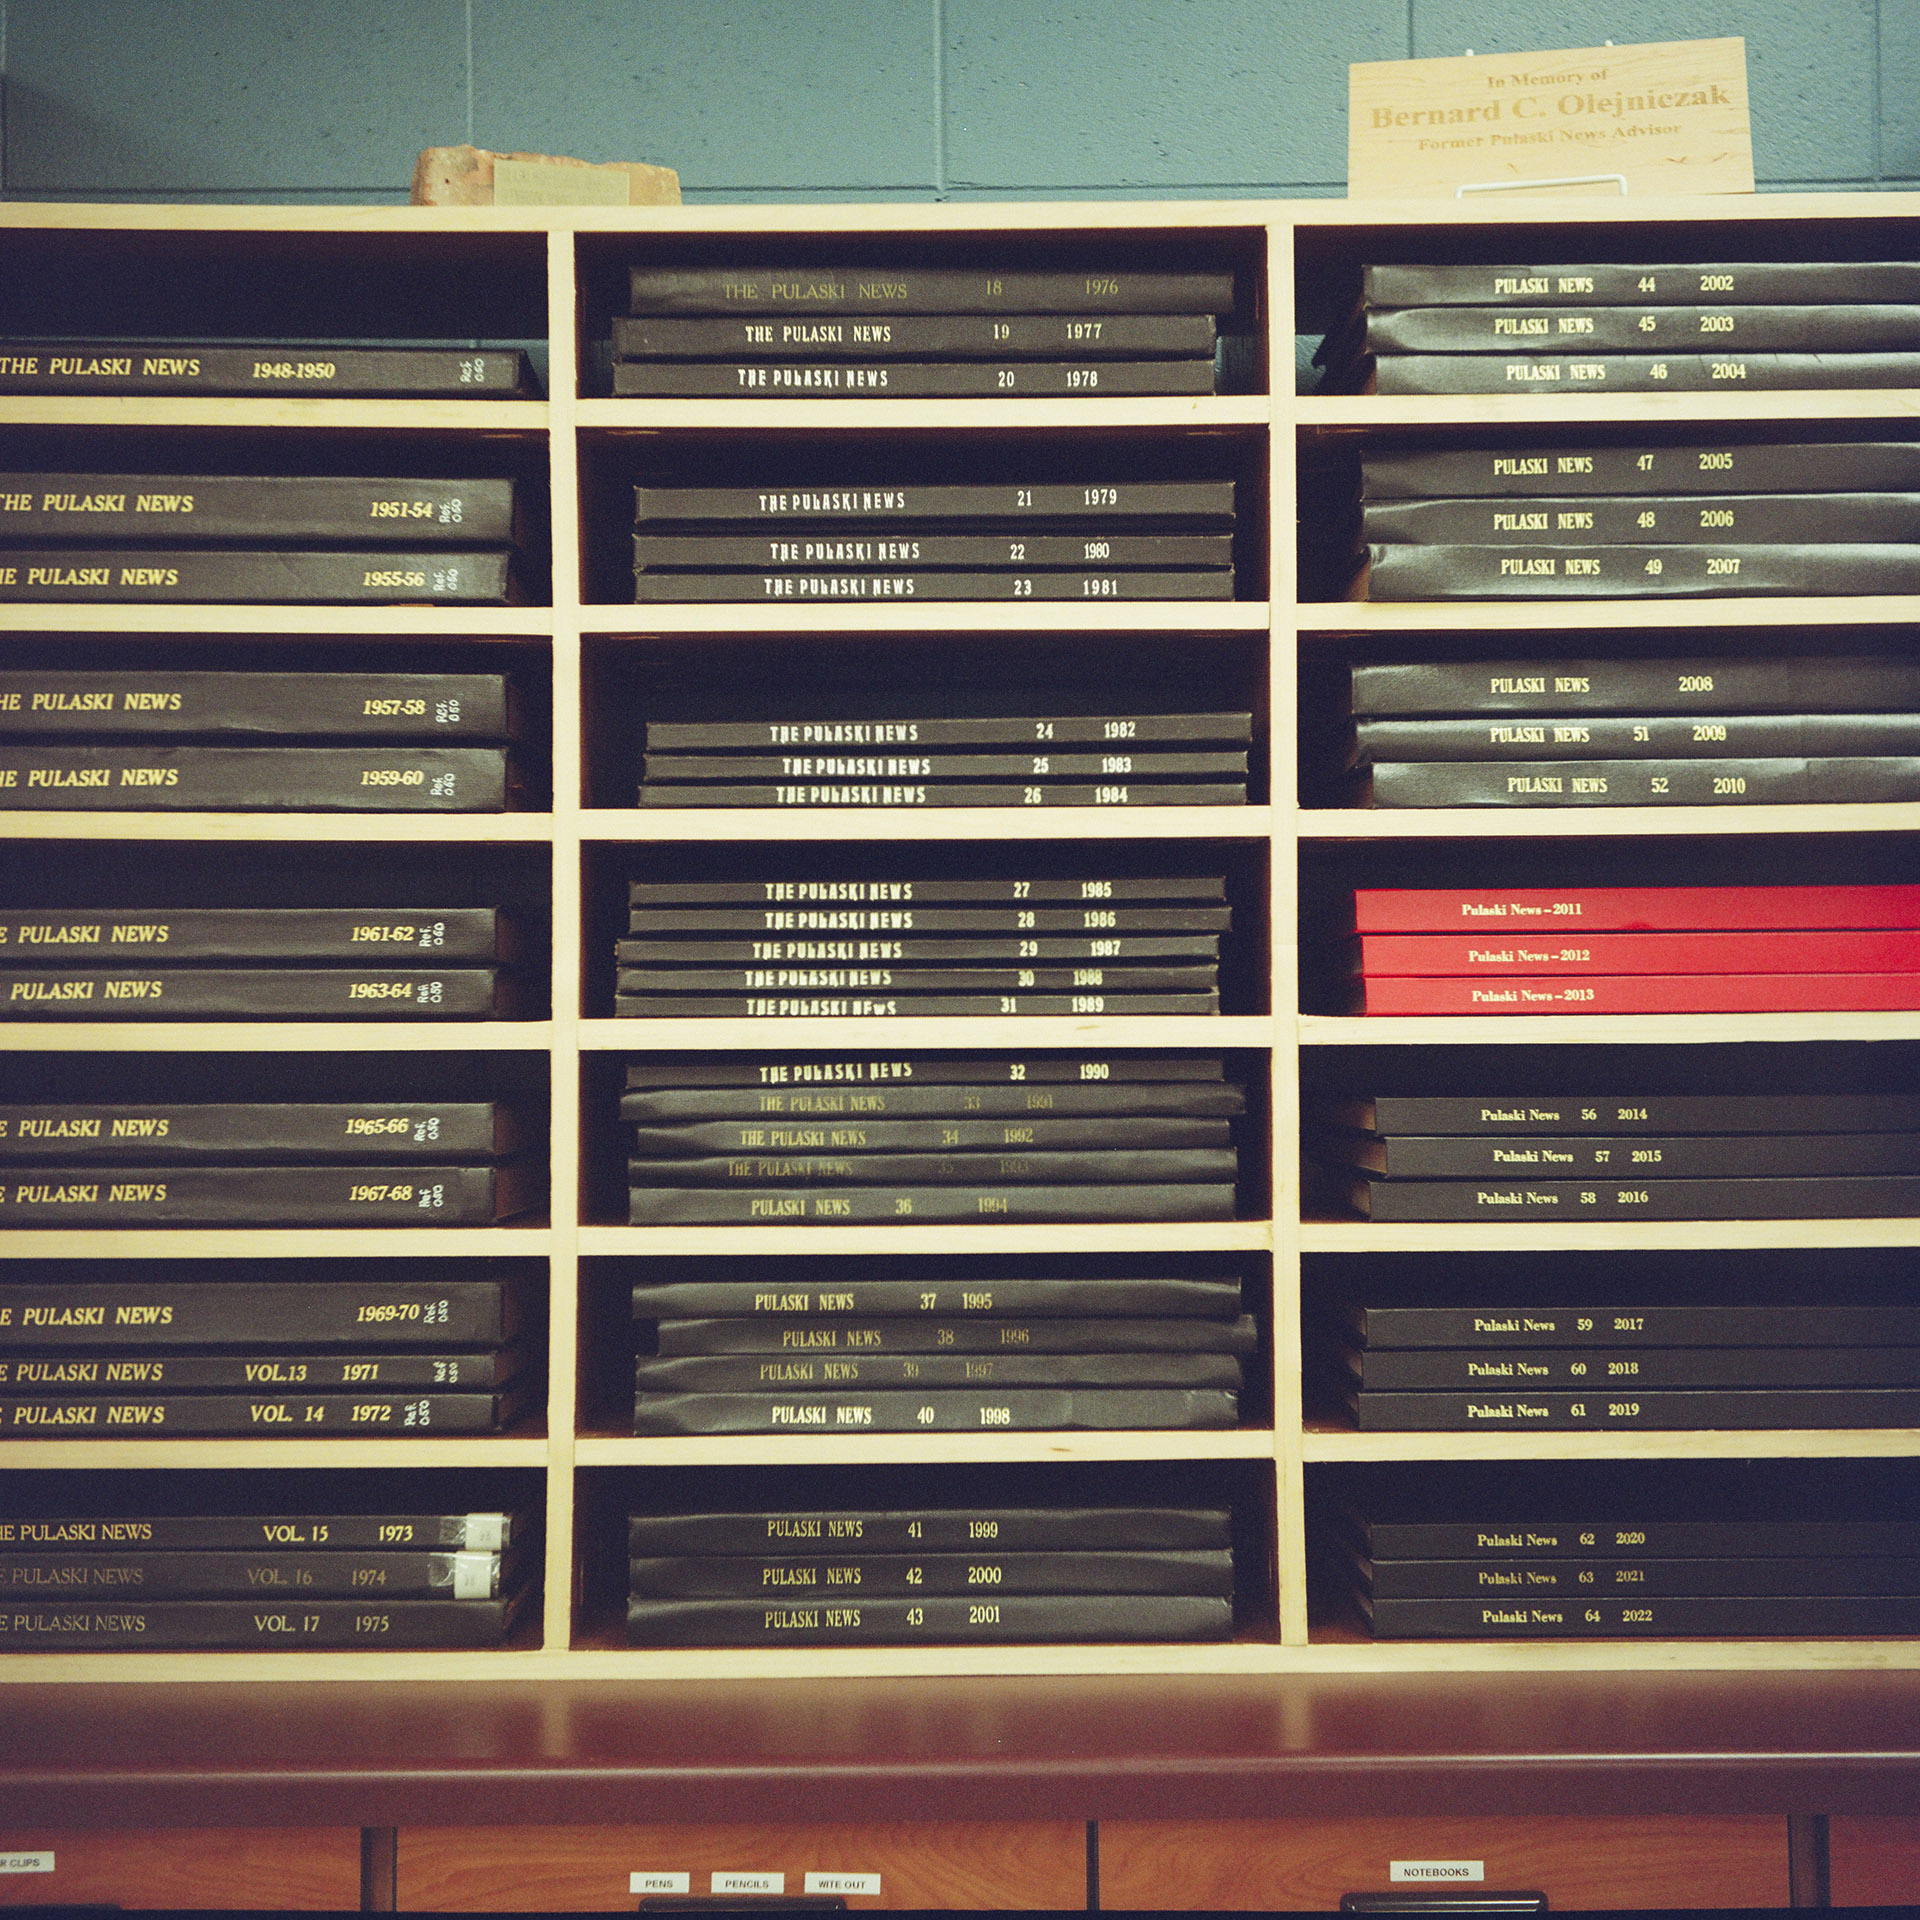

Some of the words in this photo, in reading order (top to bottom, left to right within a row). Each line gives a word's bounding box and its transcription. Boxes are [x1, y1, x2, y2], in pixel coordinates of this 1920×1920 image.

[1488, 76, 1505, 88] In
[1511, 73, 1583, 86] Memory
[1590, 69, 1608, 80] of
[1371, 100, 1500, 128] Bernard
[1512, 97, 1546, 119] C.
[1558, 84, 1730, 117] Olejniczak
[1418, 137, 1484, 150] Former
[1490, 131, 1554, 146] Pulaski
[1560, 129, 1606, 141] News
[1614, 124, 1682, 137] Advisor
[1495, 278, 1548, 294] PULASKI
[1558, 277, 1594, 294] NEWS
[1638, 277, 1656, 292] 44
[1700, 275, 1734, 291] 2002
[745, 326, 773, 342] THE
[783, 326, 842, 342] PULASKI
[854, 326, 891, 342] NEWS
[994, 324, 1009, 339] 19
[1067, 323, 1101, 339] 1977
[0, 358, 38, 374] THE
[49, 358, 131, 375] PULASKI
[143, 359, 200, 376] NEWS
[253, 363, 335, 378] 1948-1950
[738, 369, 766, 388] THE
[773, 370, 839, 388] PULASKI
[847, 370, 888, 388] NEWS
[998, 371, 1014, 387] 20
[1067, 371, 1098, 387] 1978
[1494, 458, 1548, 475] PULASKI
[1558, 457, 1593, 473] NEWS
[1637, 454, 1654, 471] 47
[1700, 453, 1733, 470] 2005
[42, 494, 124, 511] PULASKI
[136, 495, 193, 512] NEWS
[371, 502, 432, 518] 1951-54
[1501, 559, 1555, 575] PULASKI
[1566, 559, 1600, 575] NEWS
[1645, 559, 1662, 574] 49
[1708, 559, 1740, 574] 2007
[764, 579, 793, 596] THE
[800, 579, 865, 596] PULASKI
[873, 579, 914, 596] NEWS
[1014, 579, 1032, 595] 23
[1083, 579, 1117, 595] 1981
[1491, 677, 1544, 693] PULASKI
[1555, 678, 1590, 693] NEWS
[1679, 676, 1713, 692] 2008
[32, 693, 113, 710] PULASKI
[124, 694, 181, 710] NEWS
[364, 699, 426, 715] 1957-58
[770, 726, 799, 744] THE
[804, 725, 870, 743] PULASKI
[875, 724, 918, 743] NEWS
[1036, 722, 1053, 739] 24
[1105, 721, 1135, 738] 1982
[1508, 777, 1562, 792] PULASKI
[1571, 777, 1609, 794] NEWS
[1651, 777, 1669, 793] 52
[1714, 777, 1745, 794] 2010
[1462, 904, 1507, 916] Pulaski
[766, 912, 794, 930] THE
[798, 912, 865, 930] PULASKI
[870, 912, 913, 930] NEWS
[1018, 911, 1035, 928] 28
[1085, 911, 1115, 927] 1986
[18, 926, 100, 943] PULASKI
[111, 925, 168, 942] NEWS
[352, 926, 414, 941] 1961-62
[11, 982, 93, 1000] PULASKI
[104, 981, 162, 998] NEWS
[350, 983, 412, 998] 1963-64
[1472, 990, 1518, 1002] Pulaski
[760, 1066, 788, 1084] THE
[794, 1063, 862, 1081] PULASKI
[870, 1062, 912, 1080] NEWS
[1010, 1064, 1025, 1080] 32
[1081, 1063, 1108, 1079] 1990
[1481, 1109, 1525, 1121] Pulaski
[1529, 1109, 1559, 1121] News
[1581, 1108, 1597, 1120] 56
[1618, 1108, 1647, 1120] 2014
[18, 1120, 100, 1137] PULASKI
[111, 1119, 168, 1136] NEWS
[346, 1118, 409, 1135] 1965-66
[755, 1294, 808, 1311] PULASKI
[819, 1293, 854, 1311] NEWS
[920, 1293, 937, 1310] 37
[963, 1293, 992, 1309] 1995
[23, 1307, 104, 1325] PULASKI
[116, 1307, 172, 1324] NEWS
[357, 1304, 420, 1322] 1969-70
[16, 1364, 98, 1381] PULASKI
[106, 1363, 163, 1381] NEWS
[342, 1364, 378, 1380] 1971
[1468, 1363, 1512, 1376] Pulaski
[1517, 1363, 1548, 1375] News
[1570, 1363, 1587, 1375] 60
[1608, 1362, 1638, 1375] 2018
[14, 1407, 96, 1424] PULASKI
[107, 1406, 164, 1423] NEWS
[251, 1405, 292, 1422] VOL.
[305, 1406, 324, 1422] 14
[351, 1405, 391, 1421] 1972
[772, 1406, 826, 1424] PULASKI
[837, 1407, 871, 1424] NEWS
[917, 1407, 934, 1424] 40
[981, 1407, 1010, 1425] 1998
[21, 1524, 95, 1541] PULASKI
[102, 1525, 152, 1540] NEWS
[263, 1525, 304, 1542] VOL.
[313, 1526, 328, 1542] 15
[380, 1525, 413, 1541] 1973
[1477, 1534, 1522, 1546] Pulaski
[1527, 1534, 1557, 1546] News
[1579, 1533, 1595, 1545] 62
[1617, 1532, 1645, 1544] 2020
[763, 1568, 816, 1585] PULASKI
[827, 1568, 861, 1584] NEWS
[906, 1567, 922, 1584] 42
[968, 1566, 1002, 1584] 2000
[14, 1615, 89, 1631] PULASKI
[95, 1615, 145, 1631] NEWS
[254, 1615, 295, 1632] VOL.
[304, 1616, 320, 1632] 17
[356, 1615, 389, 1632] 1975
[765, 1610, 818, 1628] PULASKI
[826, 1610, 860, 1627] NEWS
[907, 1608, 923, 1625] 43
[969, 1606, 1000, 1623] 2001
[1482, 1610, 1527, 1623] Pulaski
[1532, 1610, 1562, 1623] News
[1585, 1609, 1601, 1622] 64
[1623, 1609, 1651, 1622] 2022
[10, 1858, 40, 1867] CLIPS
[1403, 1868, 1469, 1877] NOTEBOOKS
[645, 1879, 673, 1888] PENS
[725, 1879, 769, 1889] PENCILS
[818, 1879, 841, 1889] WITE
[845, 1880, 865, 1889] OUT
